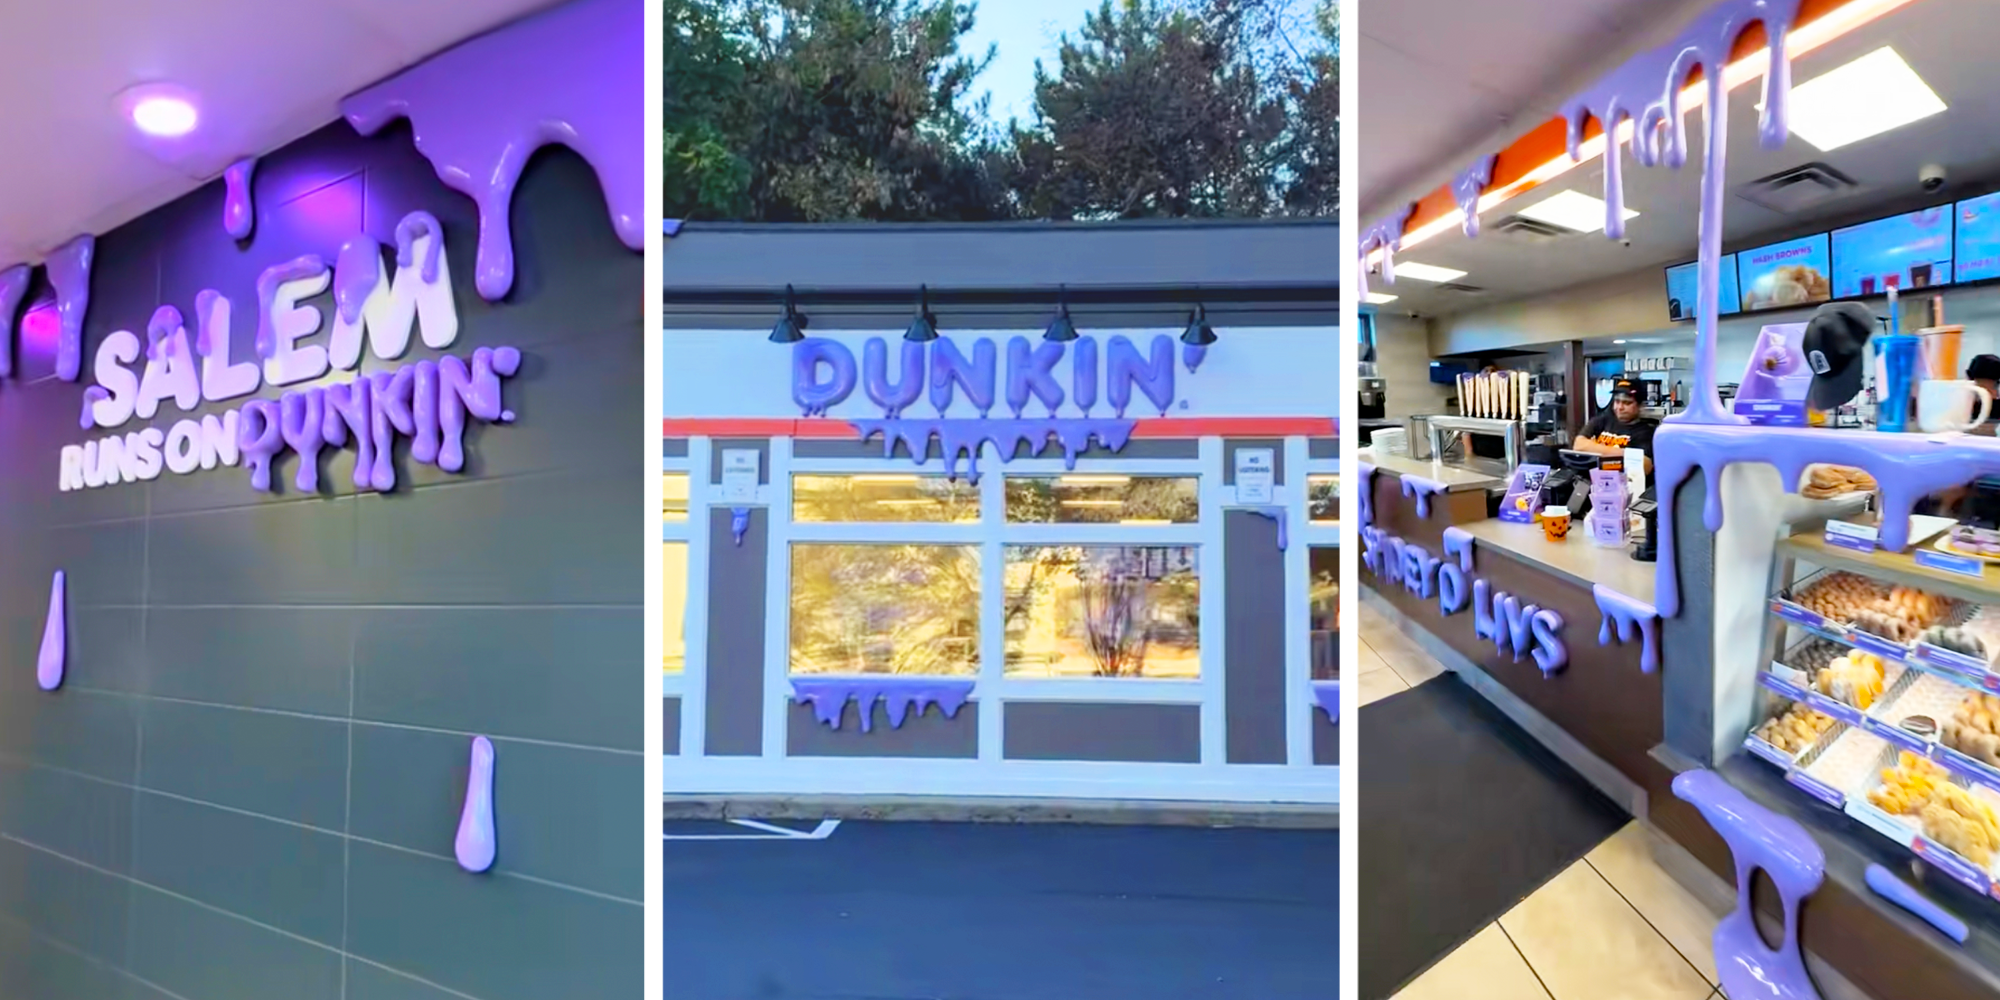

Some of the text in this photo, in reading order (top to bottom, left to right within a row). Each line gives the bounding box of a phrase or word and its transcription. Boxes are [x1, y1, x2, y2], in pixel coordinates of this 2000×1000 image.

[1752, 245, 1813, 265] HASH BROWNS
[91, 211, 459, 428] SALEM
[59, 427, 166, 491] RUNS
[164, 408, 240, 474] ON
